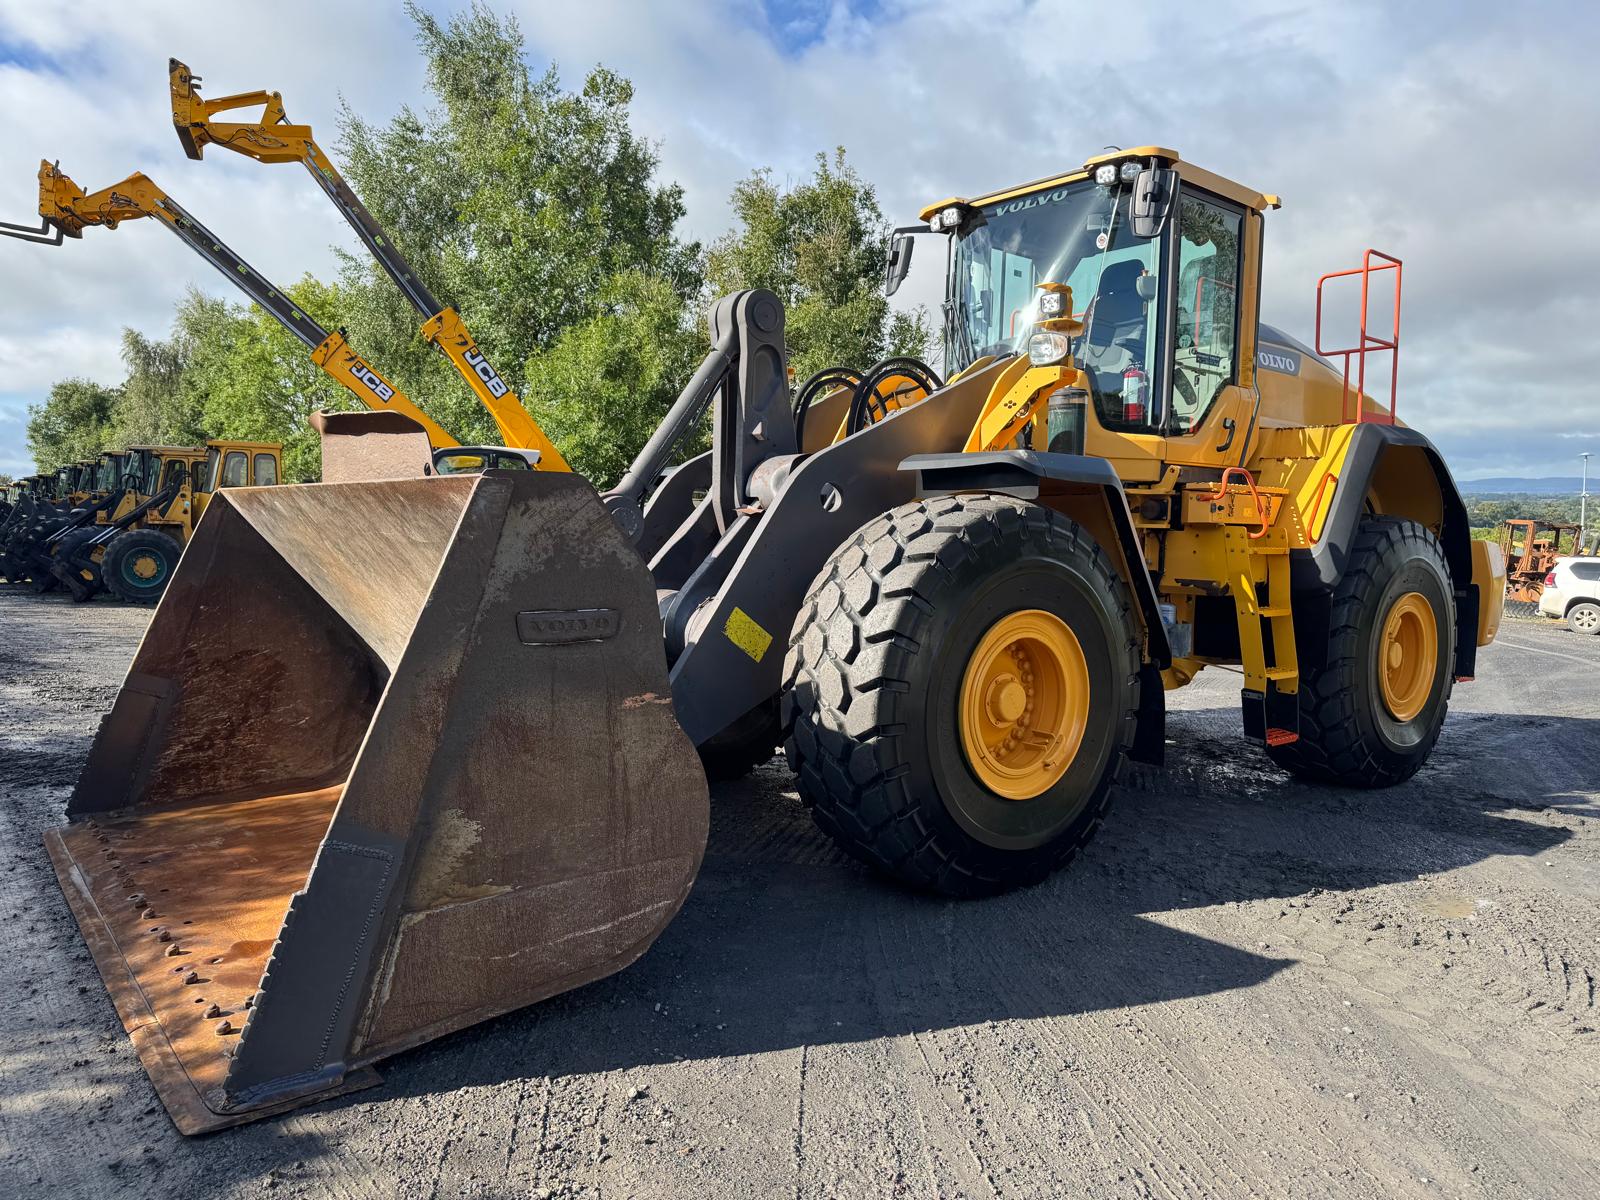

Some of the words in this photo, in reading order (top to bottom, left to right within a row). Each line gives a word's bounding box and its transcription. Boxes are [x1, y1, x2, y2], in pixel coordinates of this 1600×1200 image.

[996, 190, 1068, 216] VOLVO
[463, 348, 509, 398] JCB
[1257, 351, 1295, 372] OLVO
[349, 361, 394, 401] JCB
